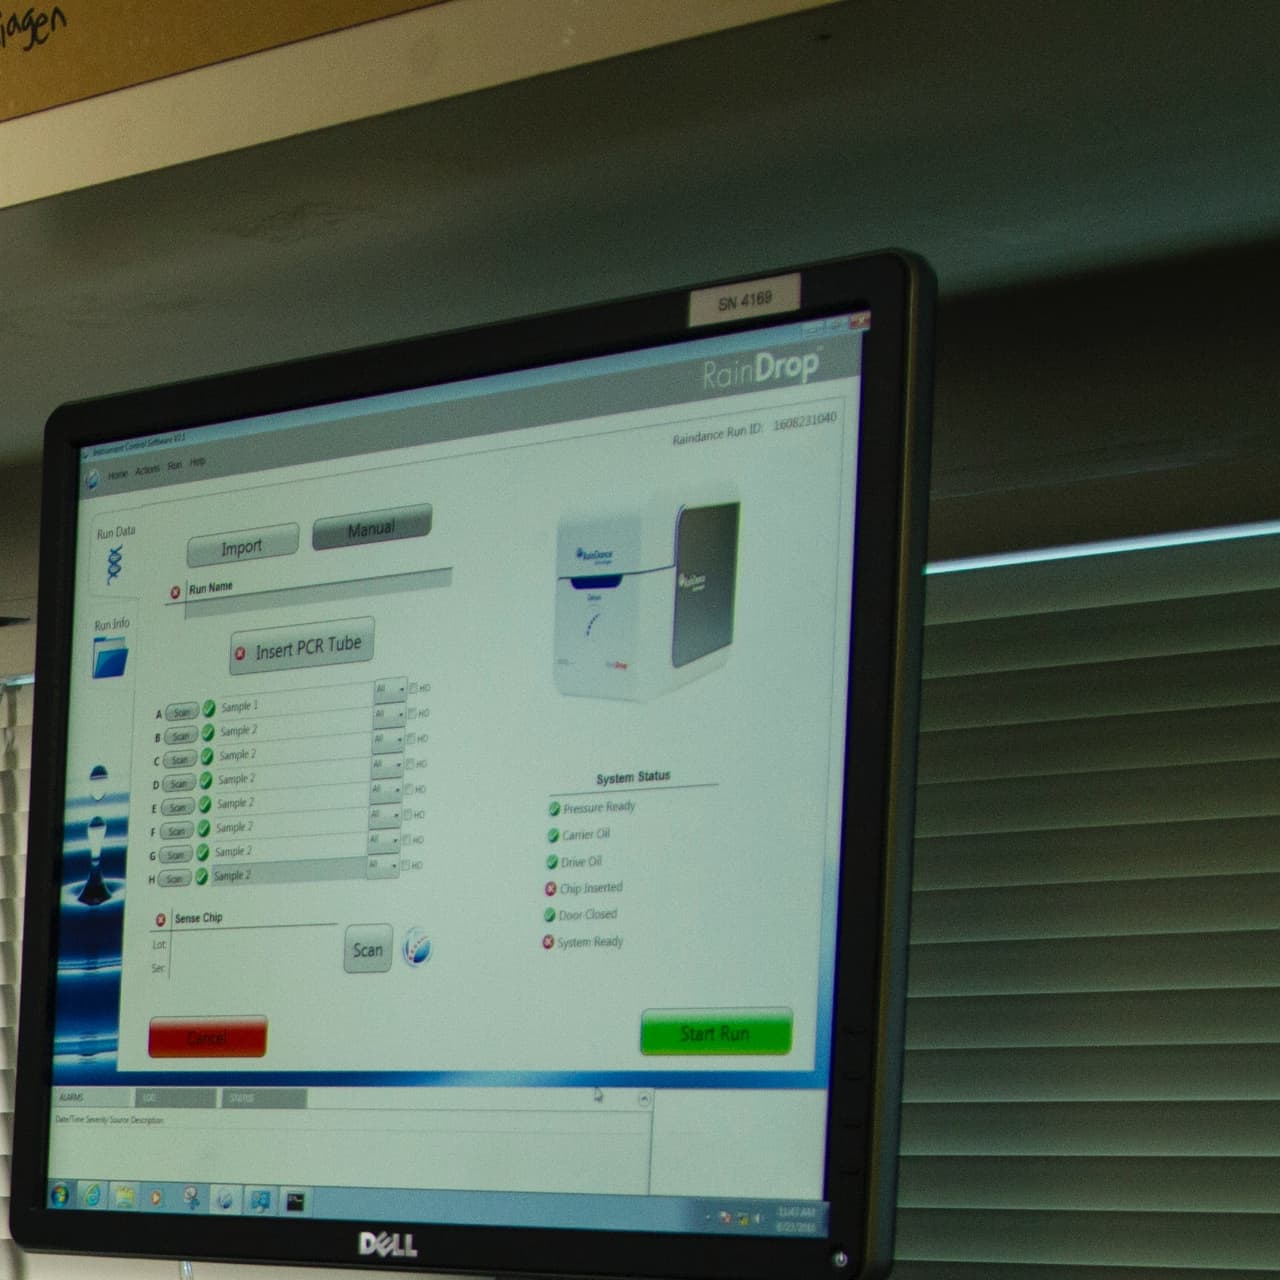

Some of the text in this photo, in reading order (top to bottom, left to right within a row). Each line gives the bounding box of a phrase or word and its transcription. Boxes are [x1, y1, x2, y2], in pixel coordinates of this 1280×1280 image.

[718, 290, 772, 312] SN 4169
[672, 428, 726, 448] Raindance
[728, 424, 745, 439] Run
[747, 421, 763, 437] ID:
[108, 457, 207, 480] Home Actions Run Help
[97, 525, 137, 541] Run Data
[348, 520, 396, 539] Manual
[221, 538, 263, 558] Import
[189, 580, 234, 595] Run Name
[94, 617, 131, 631] Run Info
[256, 634, 362, 661] Insert PCR Tube
[156, 710, 162, 720] A
[221, 702, 251, 715] Sample
[254, 700, 259, 710] 1
[155, 734, 161, 743] B
[220, 726, 250, 738] Sample
[251, 724, 258, 734] 2
[153, 757, 160, 766] C
[219, 750, 249, 762] Sample
[251, 748, 258, 758] 2
[153, 781, 159, 790] D
[218, 774, 248, 786] Sample
[249, 772, 256, 783] 2
[596, 770, 672, 788] System Status
[152, 804, 158, 813] E
[217, 798, 246, 811] Sample
[248, 797, 255, 807] 2
[563, 800, 636, 815] Pressure Ready
[150, 828, 156, 837] F
[216, 822, 245, 834] Sample
[247, 820, 254, 830] 2
[562, 828, 611, 841] Carrier Oil
[149, 852, 156, 861] G
[215, 846, 245, 858] Sample
[246, 845, 253, 855] 2
[561, 855, 602, 868] Drive Oil
[149, 875, 156, 884] H
[214, 869, 244, 882] Sample
[245, 869, 252, 880] 2
[560, 881, 623, 896] Chip Inserted
[175, 911, 223, 925] Sense Chip
[559, 908, 618, 921] Door Closed
[353, 942, 384, 958] Scan
[558, 935, 624, 949] System Ready
[681, 1025, 751, 1042] Start Run
[358, 1231, 419, 1258] DELL
